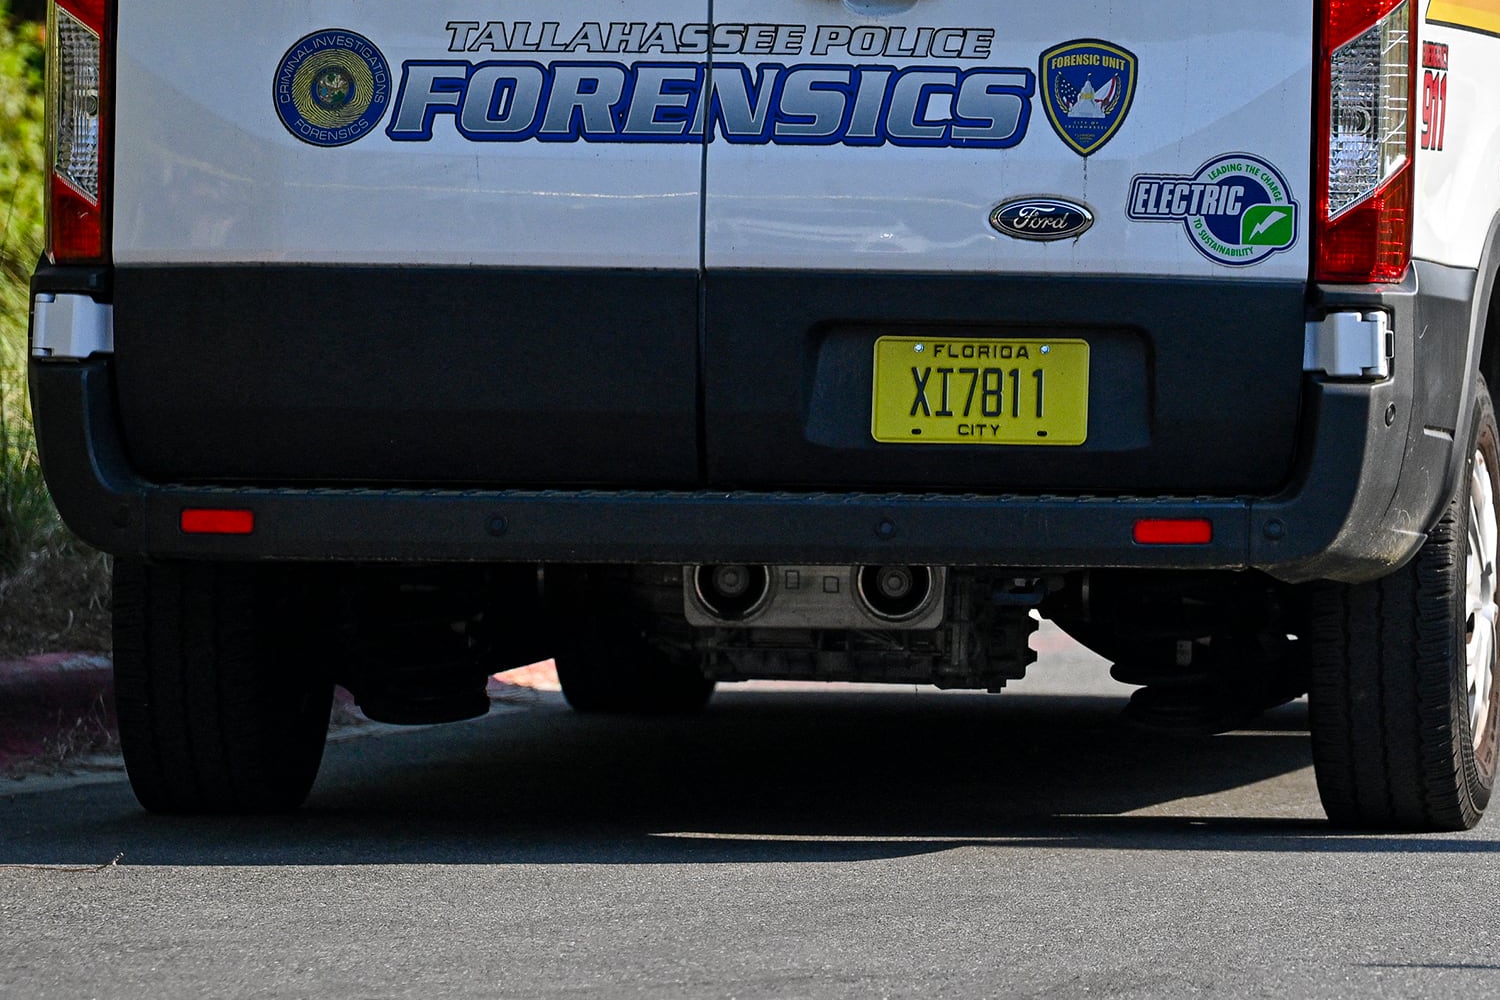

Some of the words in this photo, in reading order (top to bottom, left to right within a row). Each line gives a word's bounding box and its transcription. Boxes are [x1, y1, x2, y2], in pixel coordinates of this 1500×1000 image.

[446, 21, 805, 53] TALLAHASSEE
[810, 24, 996, 59] POLICE
[280, 45, 313, 104] CRIMINAL
[312, 35, 387, 104] INVESTIGATIONS
[1051, 54, 1100, 70] FORENSIC
[1102, 55, 1126, 71] UNIT
[386, 59, 1035, 146] FORENSICS
[1421, 70, 1448, 151] 911
[294, 118, 370, 141] FORENSICS
[1134, 183, 1244, 215] ELECTRIC
[1208, 163, 1243, 181] LEADING
[1245, 164, 1261, 177] THE
[1260, 172, 1283, 202] CHARGE
[1013, 206, 1068, 231] Ford
[1193, 218, 1203, 230] TO
[1198, 229, 1254, 257] SUSTAINABILITY
[933, 344, 1029, 359] FLORIDA
[910, 366, 1045, 418] XI7811
[957, 423, 1000, 437] CITY
